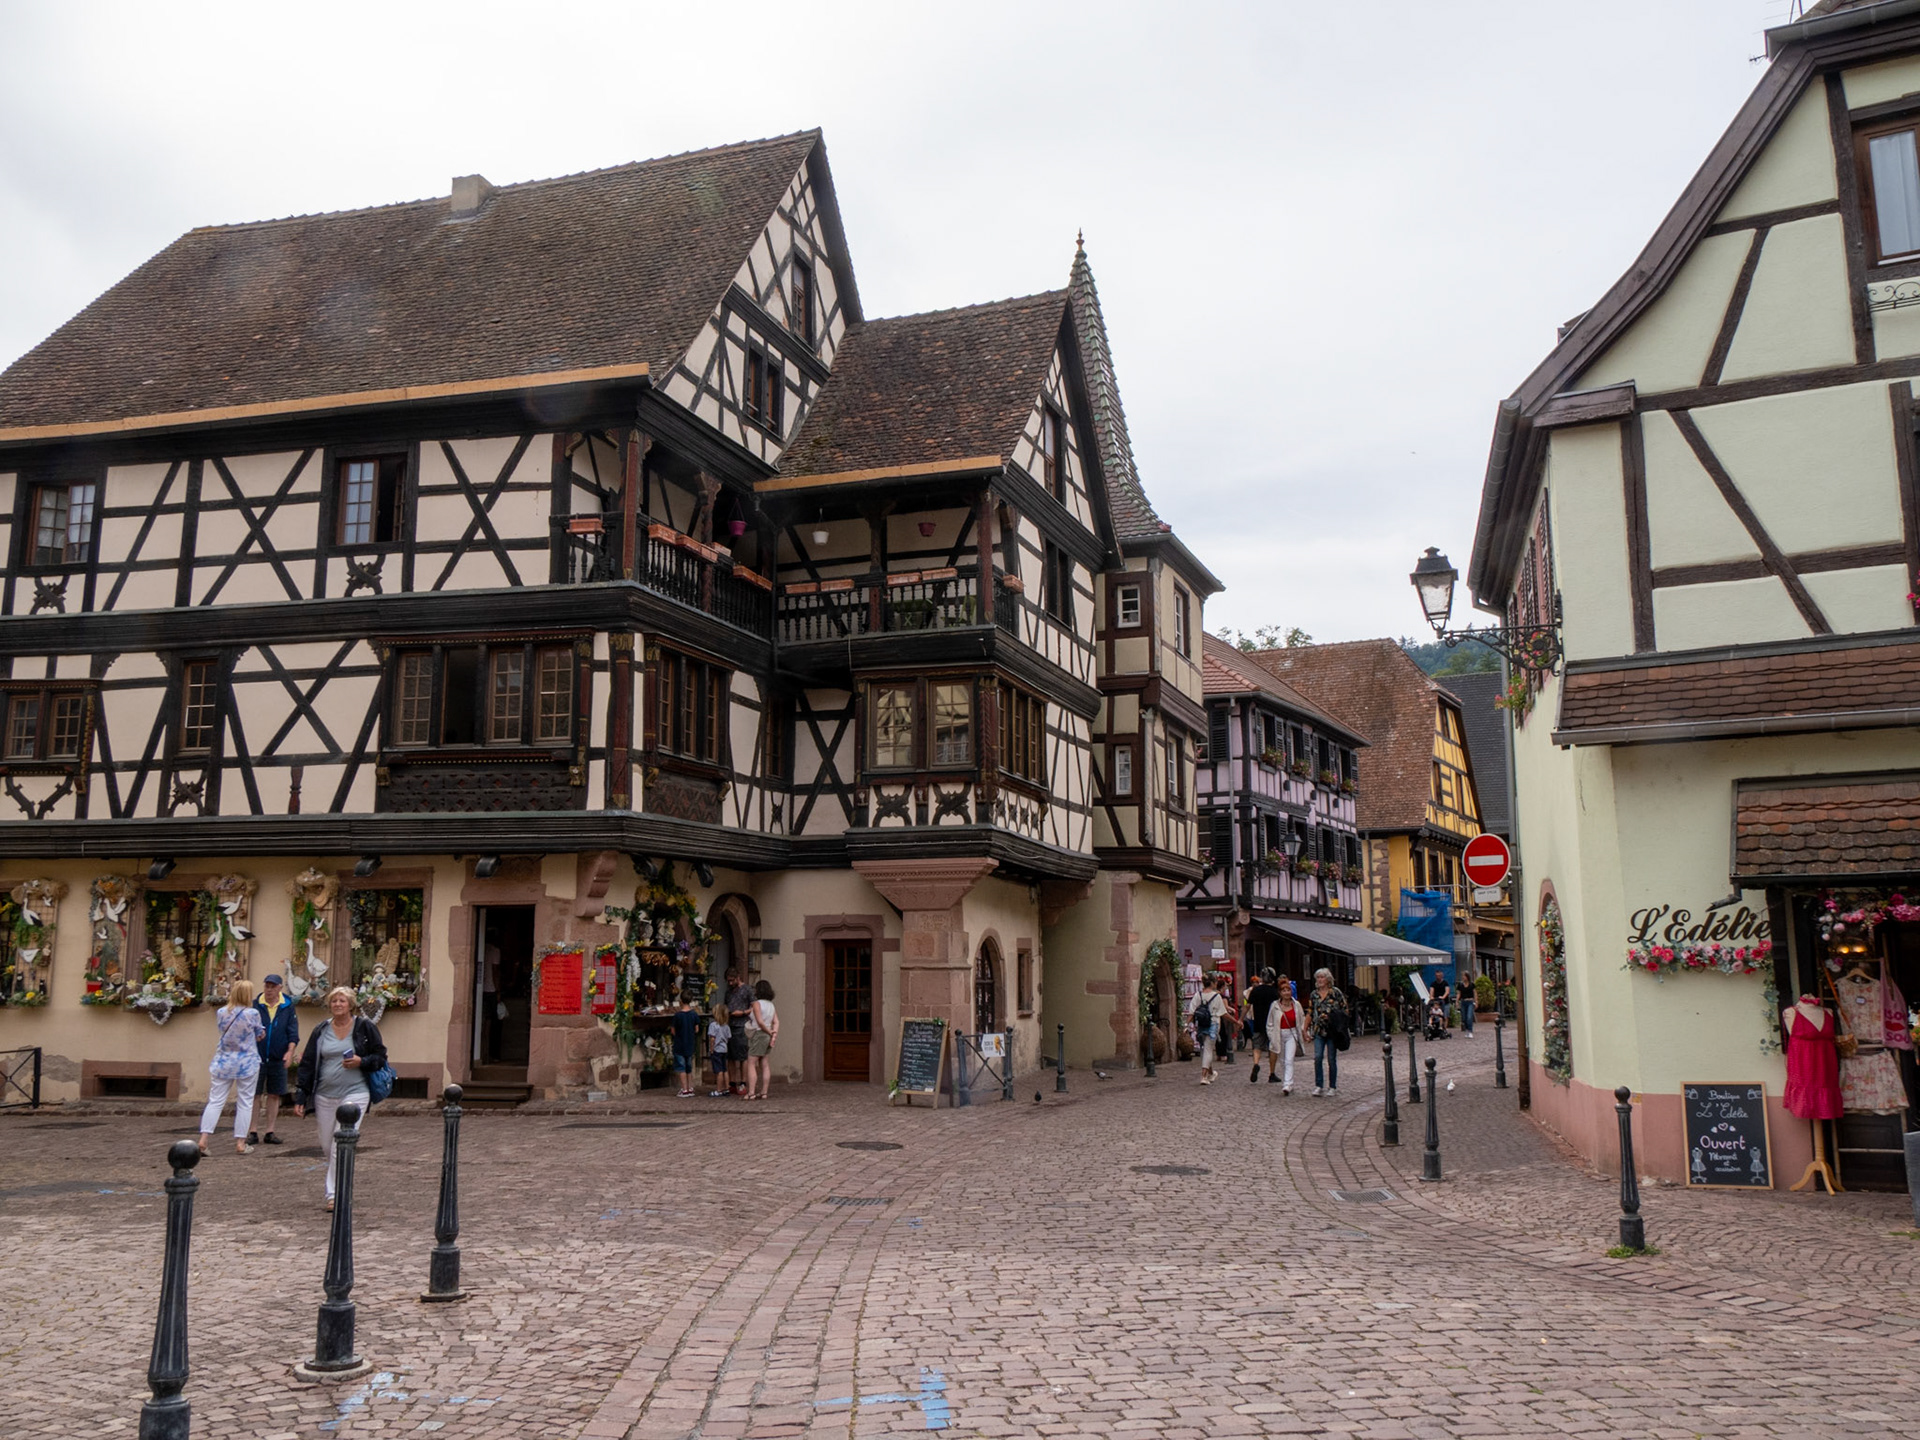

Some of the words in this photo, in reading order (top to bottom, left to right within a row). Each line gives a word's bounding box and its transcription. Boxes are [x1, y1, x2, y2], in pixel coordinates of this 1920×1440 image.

[1627, 904, 1771, 944] L'Edélie
[1708, 1089, 1741, 1101] Boutique
[1700, 1135, 1746, 1150] Ouvert
